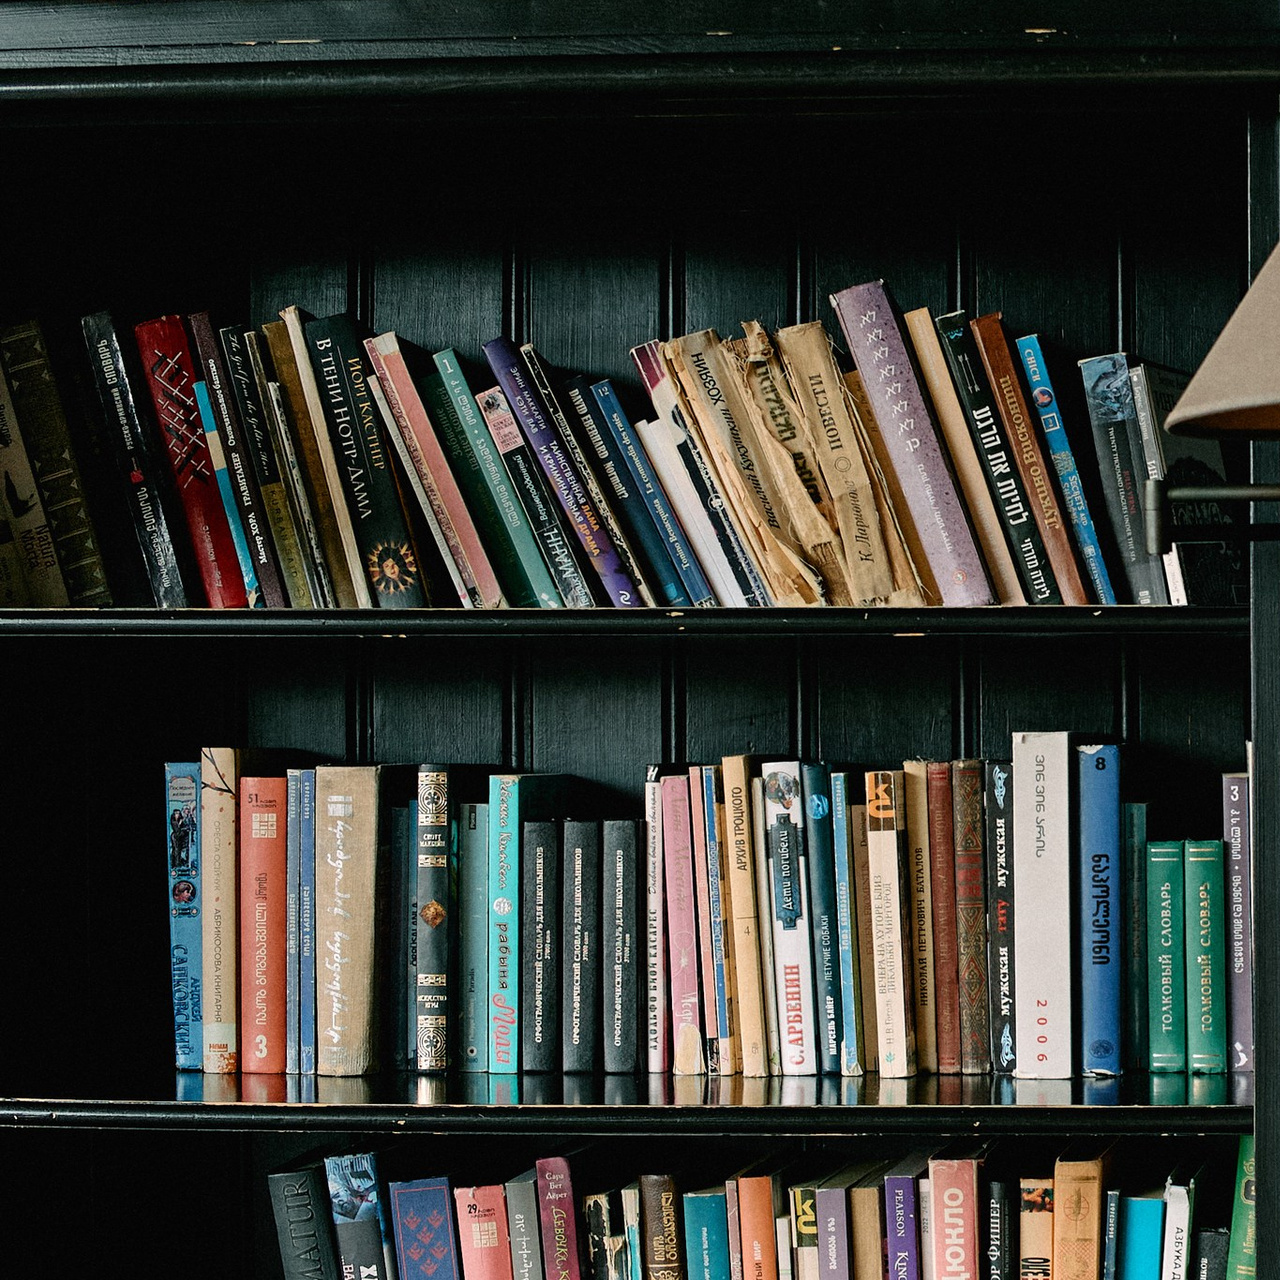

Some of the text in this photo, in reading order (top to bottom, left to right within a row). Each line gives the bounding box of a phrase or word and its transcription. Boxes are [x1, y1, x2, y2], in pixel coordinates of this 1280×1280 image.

[510, 367, 547, 430] ЭРИН МАККАРТИ
[809, 372, 843, 450] ПОВЕСТИ
[1024, 349, 1041, 383] CHICK
[316, 337, 372, 520] В ТЕНИ НОТР-ДАМА
[348, 357, 385, 470] ЙОРГ КАСТНЕР
[996, 374, 1060, 531] Лукино Висконти
[549, 439, 600, 532] ТАИНСТВЕННАЯ ЛАМА
[972, 405, 1028, 526] לחיות את הרגע
[20, 529, 40, 570] Morta
[34, 524, 56, 568] Natura
[269, 489, 298, 578] KURBAN SAID
[779, 829, 793, 910] Дети погибели
[1091, 853, 1110, 965] ნაპოლეონი
[915, 847, 927, 1005] НИКОЛАЙ ПЕТРОВИЧ БАТАЛОВ
[995, 818, 1011, 1016] мужская тату мужская
[1158, 881, 1172, 1032] ТОЛКОВЫЙ СЛОВАРЬ
[1198, 881, 1212, 1033] ТОЛКОВЫЙ СЛОВАРЬ
[171, 944, 191, 1056] САПКОВСКИЙ
[190, 976, 201, 1022] АНДЖЕЙ
[784, 963, 804, 1065] С. АРБЕНИН
[465, 1204, 478, 1215] 29
[545, 1171, 565, 1181] Сара
[752, 1240, 762, 1260] МИР
[1021, 1256, 1050, 1276] ЗЛО
